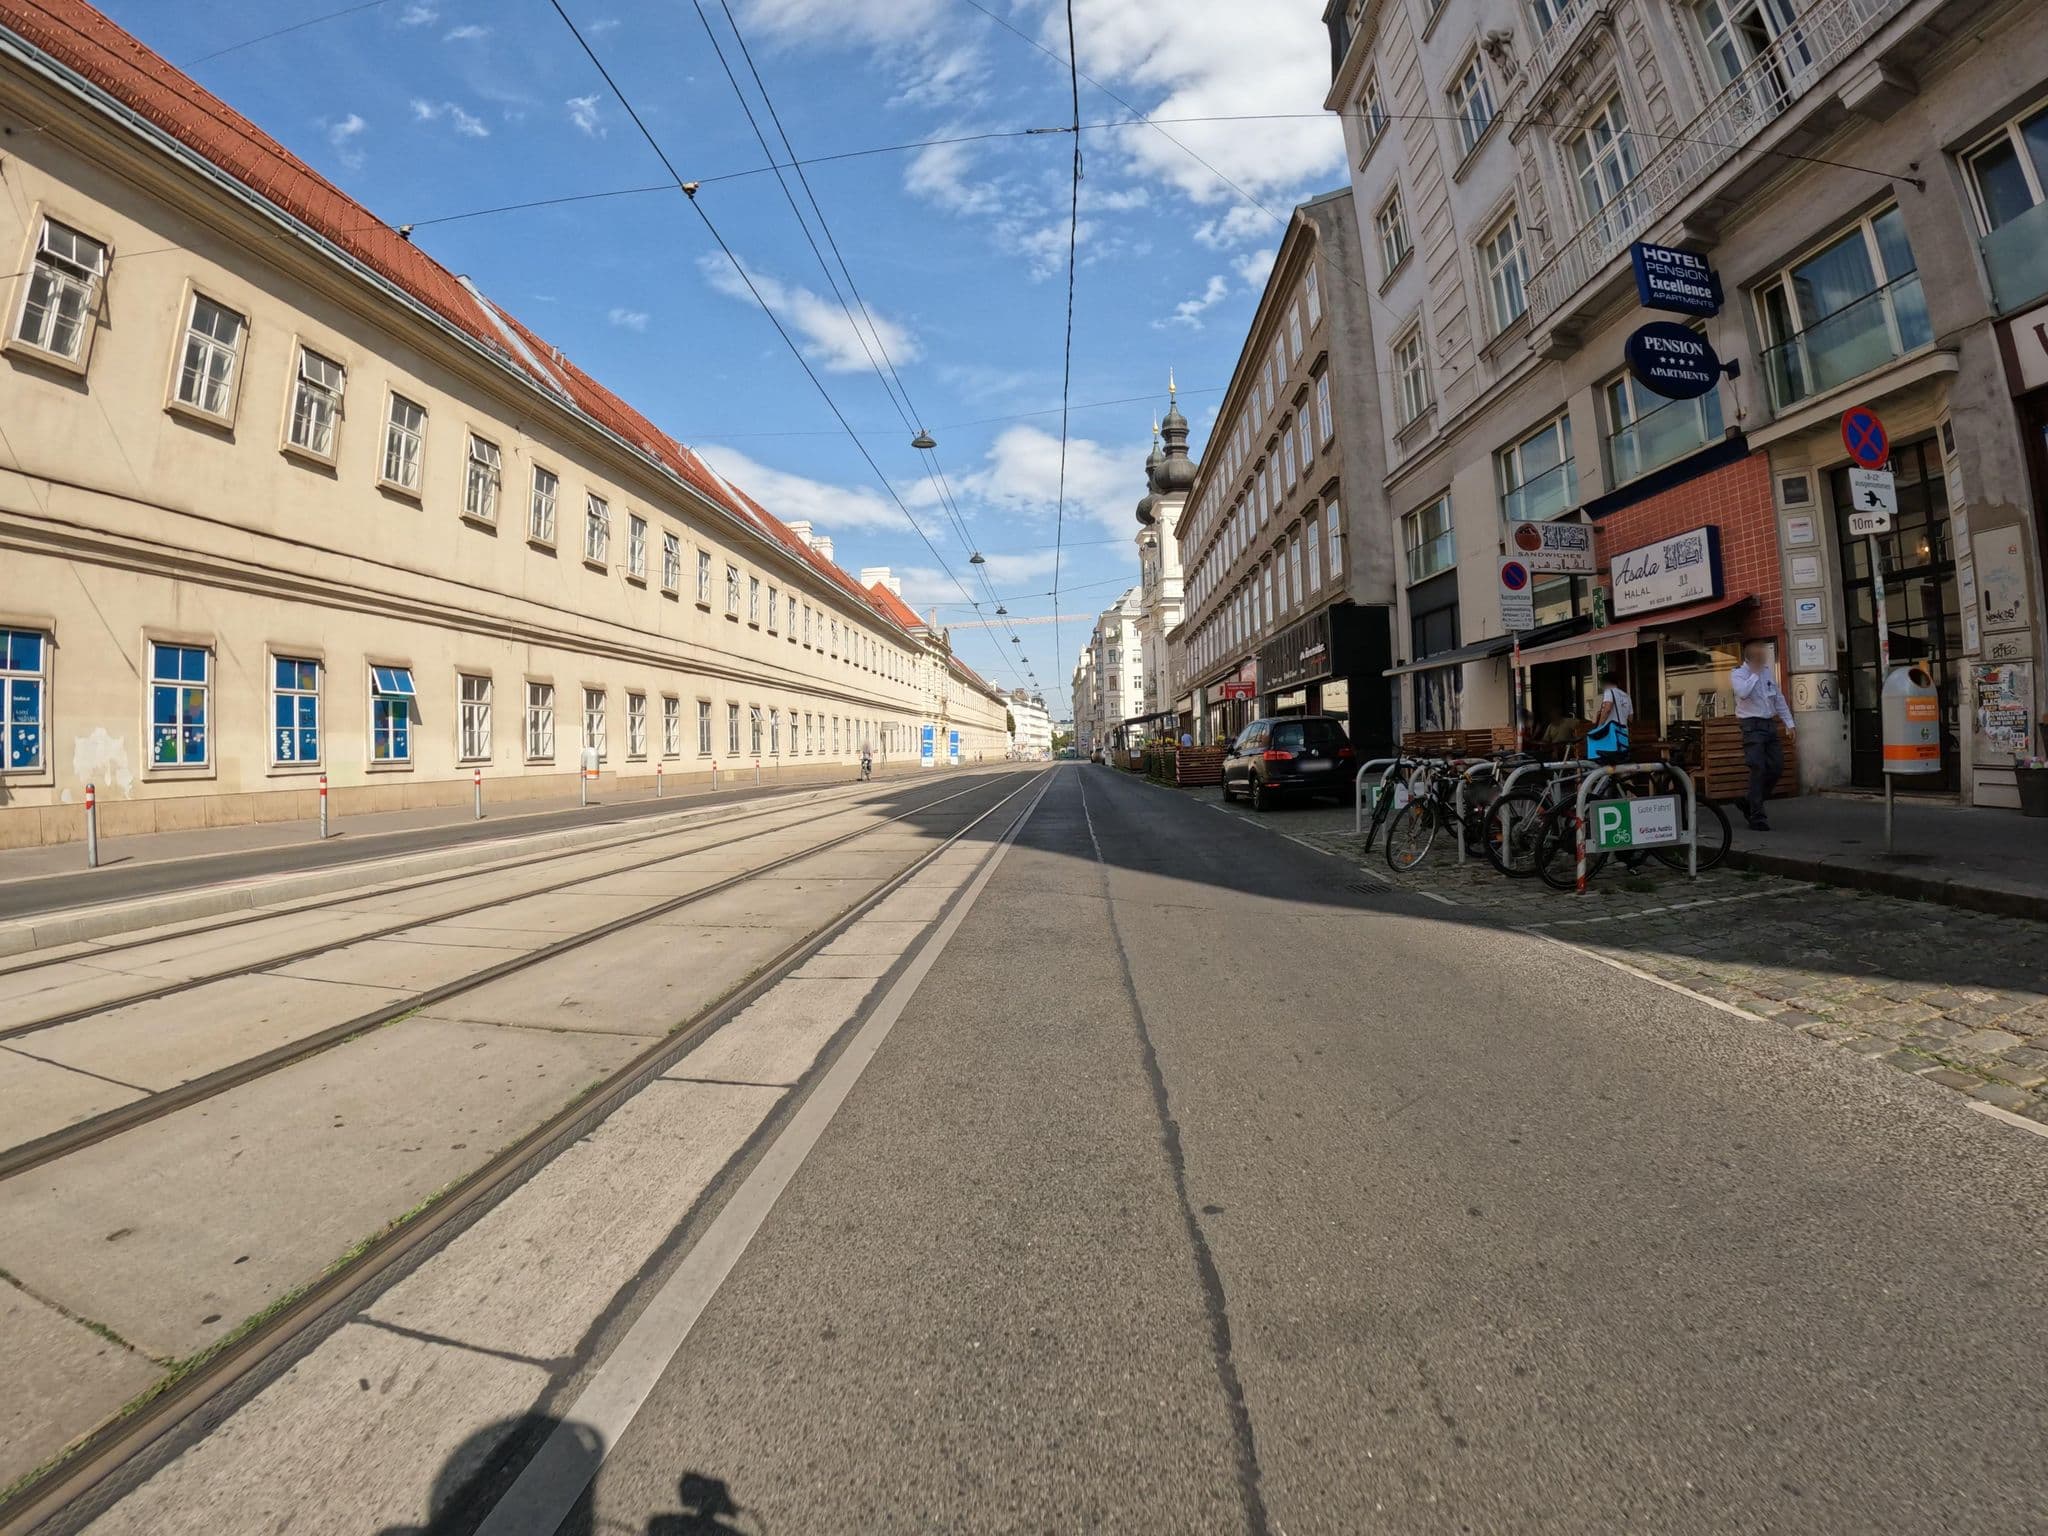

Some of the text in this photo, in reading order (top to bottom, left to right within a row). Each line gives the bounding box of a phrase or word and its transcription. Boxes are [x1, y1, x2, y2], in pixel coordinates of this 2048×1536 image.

[1642, 247, 1706, 270] HOTEL
[1645, 261, 1709, 282] PENSION
[1649, 274, 1712, 299] Excellence
[1653, 291, 1715, 308] APARTMENTS
[1644, 336, 1704, 356] PENSION
[1650, 367, 1710, 382] APARTMENTS
[1852, 517, 1874, 531] 10m
[1517, 551, 1582, 559] SANDWICHES
[1615, 553, 1660, 587] Asala
[1624, 586, 1651, 600] HALAL
[1598, 806, 1622, 845] P
